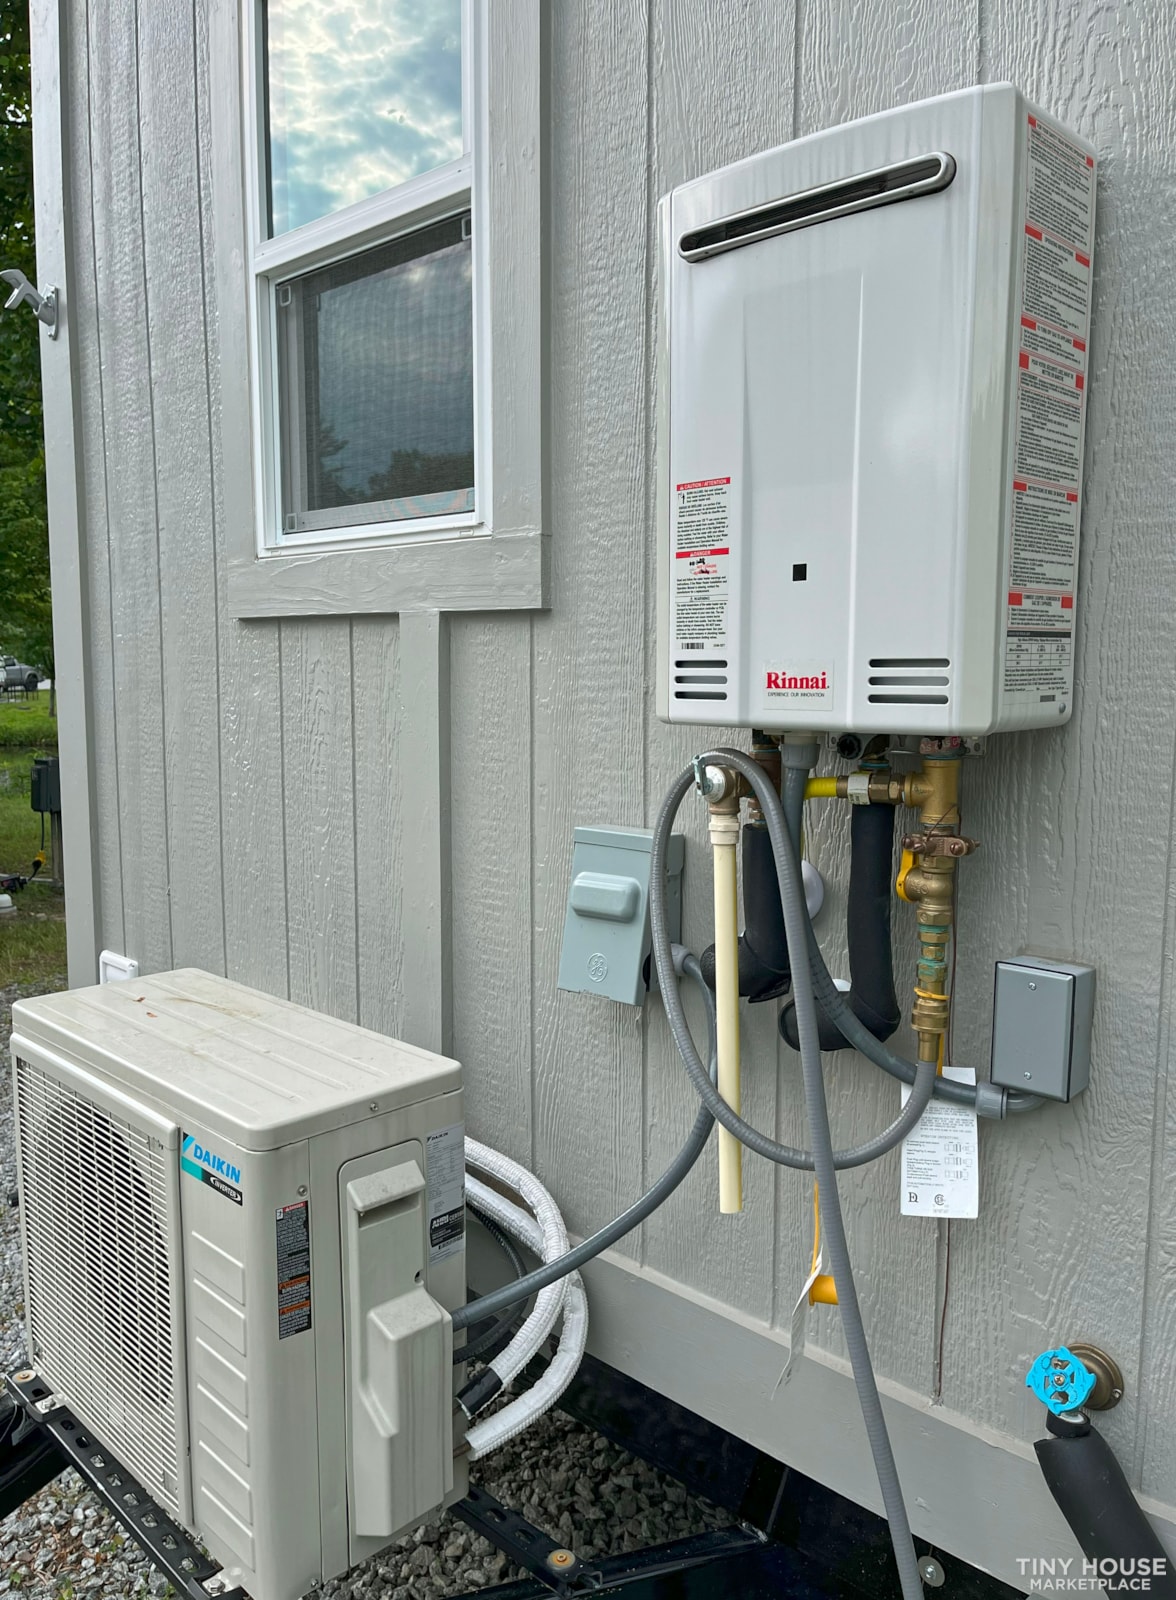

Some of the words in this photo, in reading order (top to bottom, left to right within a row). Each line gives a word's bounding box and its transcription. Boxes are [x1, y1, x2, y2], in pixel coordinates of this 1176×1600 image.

[766, 671, 827, 689] Rinnai
[193, 1144, 241, 1184] DAIKIN
[214, 1179, 237, 1198] INVERTER
